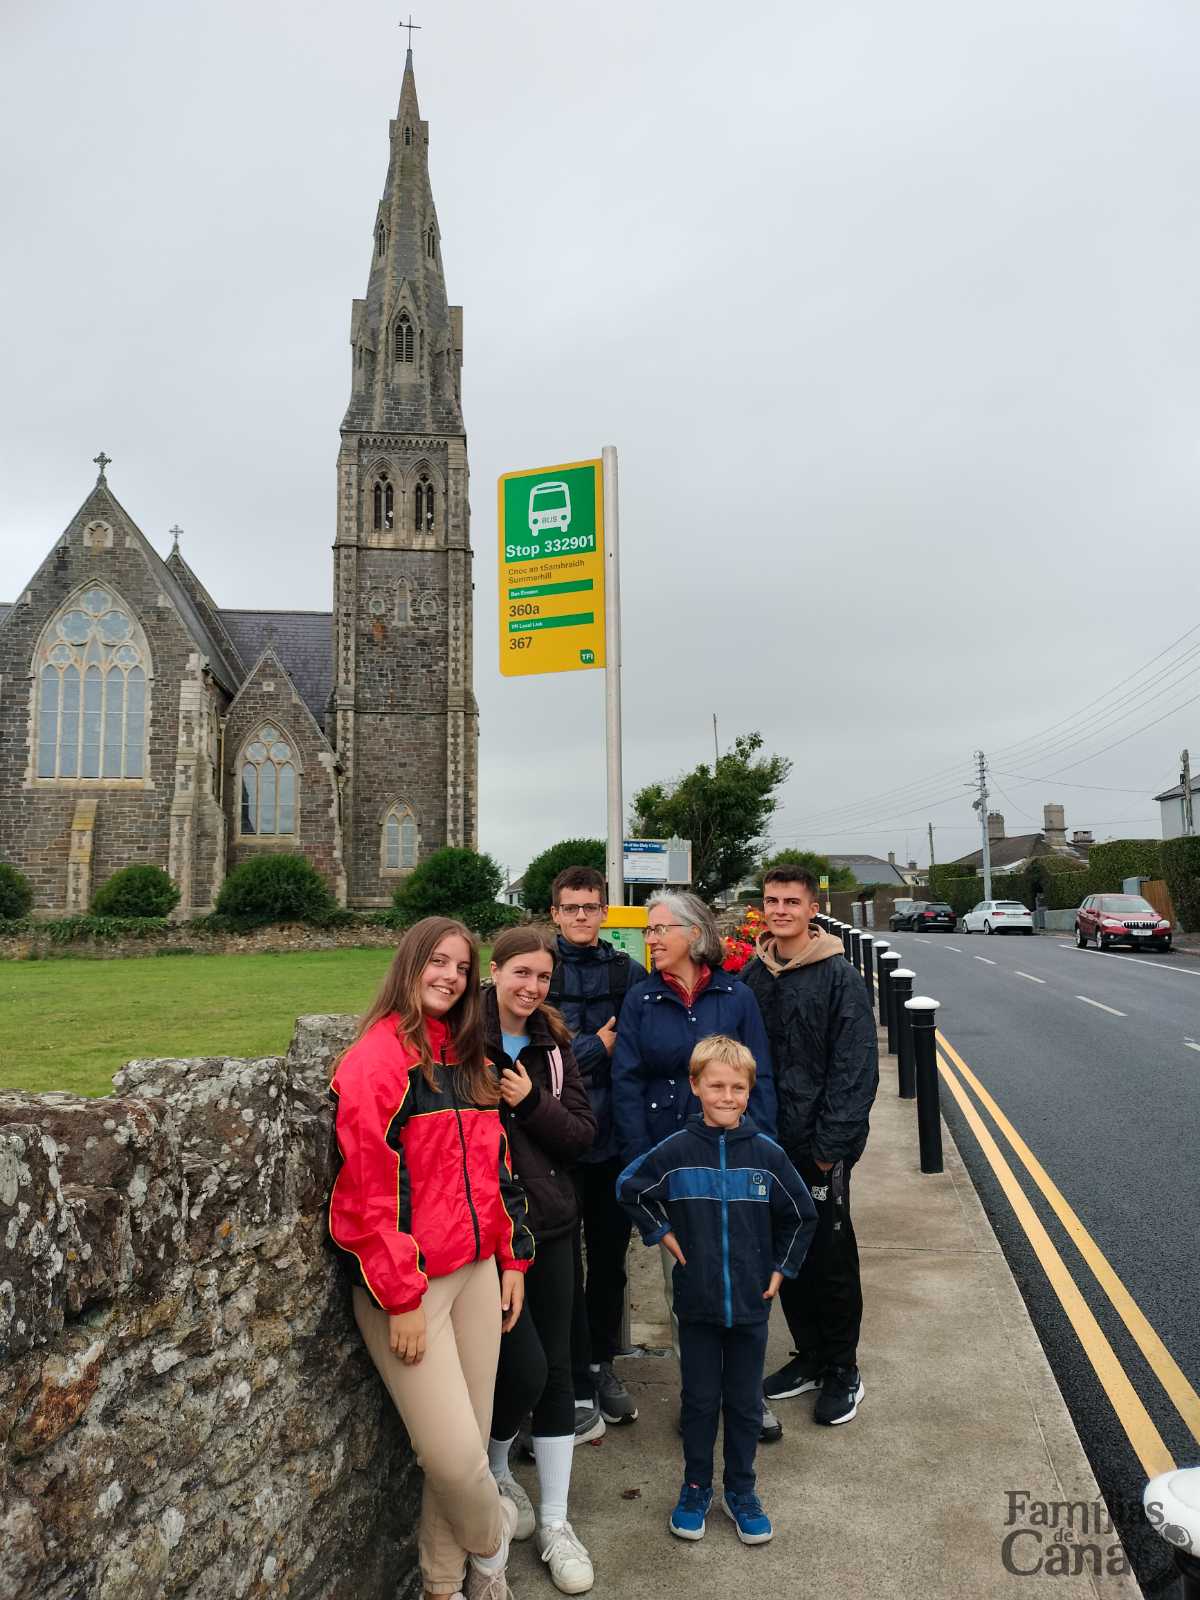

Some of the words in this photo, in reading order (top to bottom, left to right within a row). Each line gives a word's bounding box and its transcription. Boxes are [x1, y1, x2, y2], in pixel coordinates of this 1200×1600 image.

[506, 544, 540, 558] Stop
[544, 534, 594, 552] 332901
[508, 571, 552, 584] Summerhill
[509, 603, 540, 617] 360a
[509, 636, 533, 650] 367
[582, 652, 594, 661] TFI
